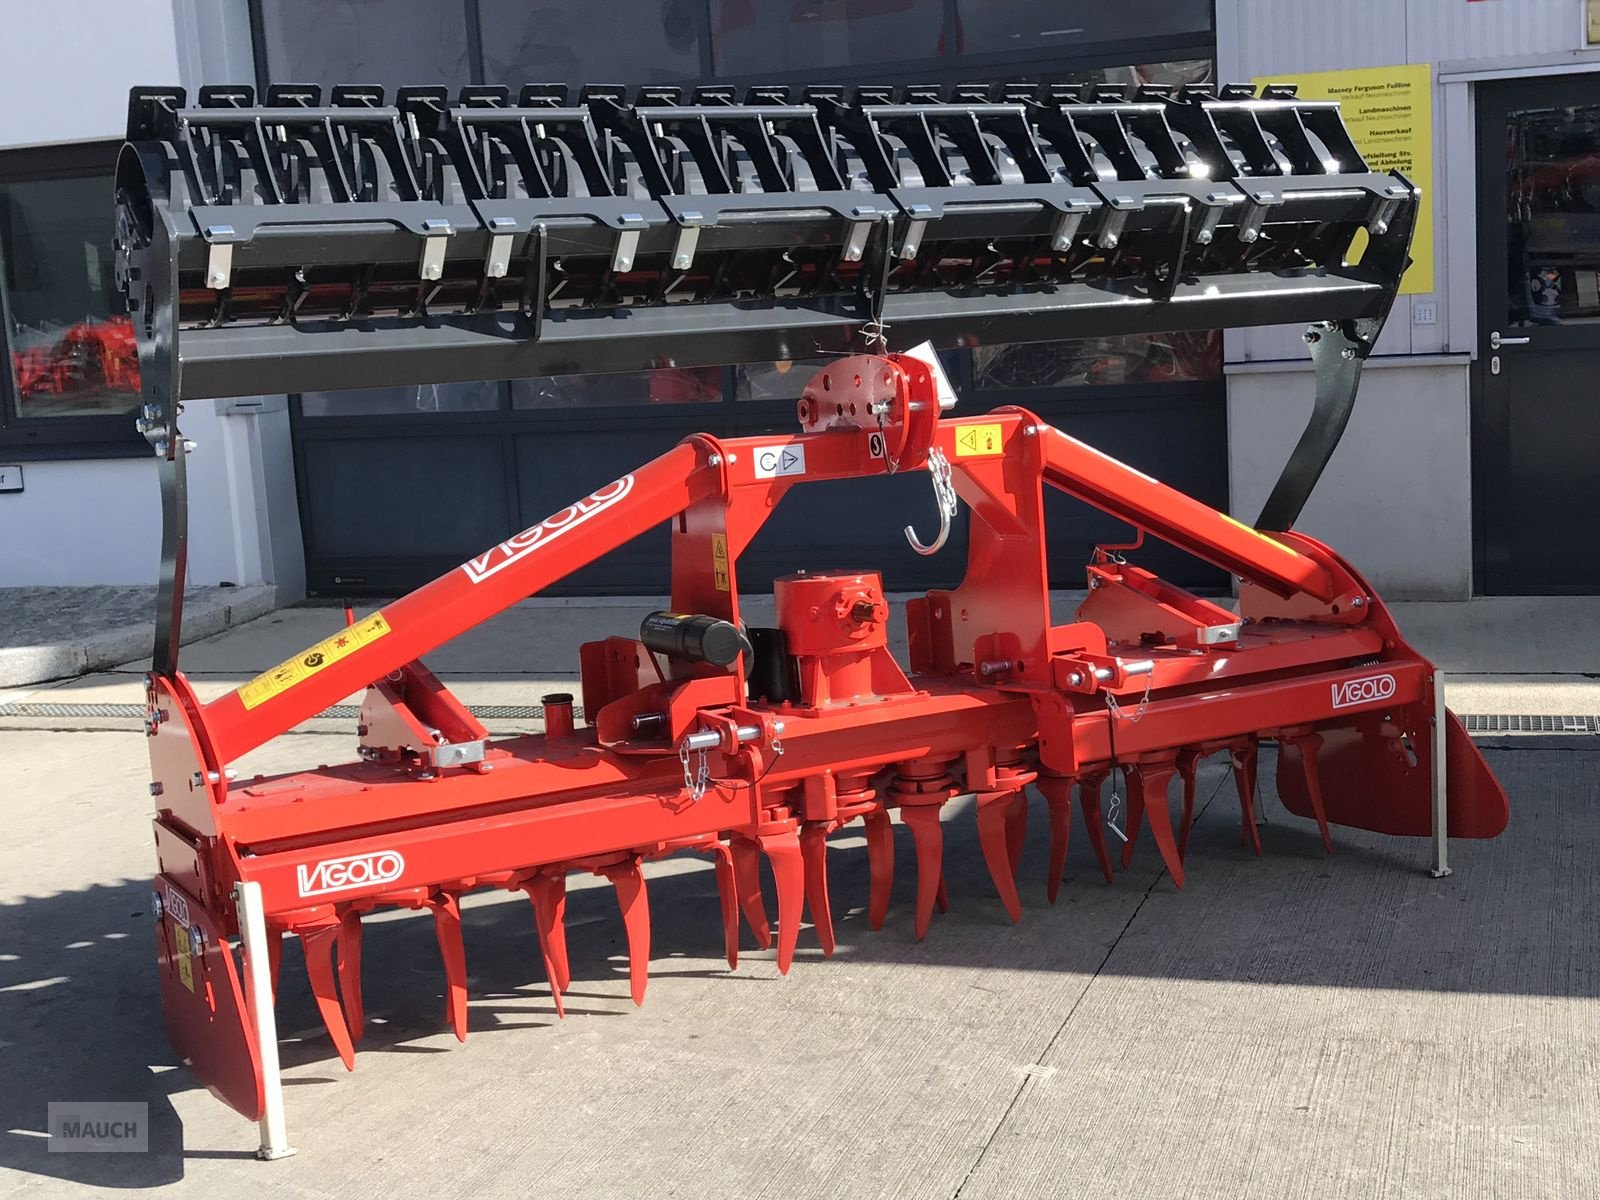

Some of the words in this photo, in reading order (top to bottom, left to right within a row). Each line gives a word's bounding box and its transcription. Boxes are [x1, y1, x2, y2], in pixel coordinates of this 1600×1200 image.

[1354, 84, 1385, 92] Ferguson
[1359, 105, 1412, 115] Landmaschinen
[1369, 127, 1412, 136] Hausverkauf
[1363, 136, 1412, 144] Landmaschinen
[460, 473, 635, 584] VIGOLO
[1331, 674, 1396, 709] VIGOLO
[297, 850, 405, 897] VIGOLO
